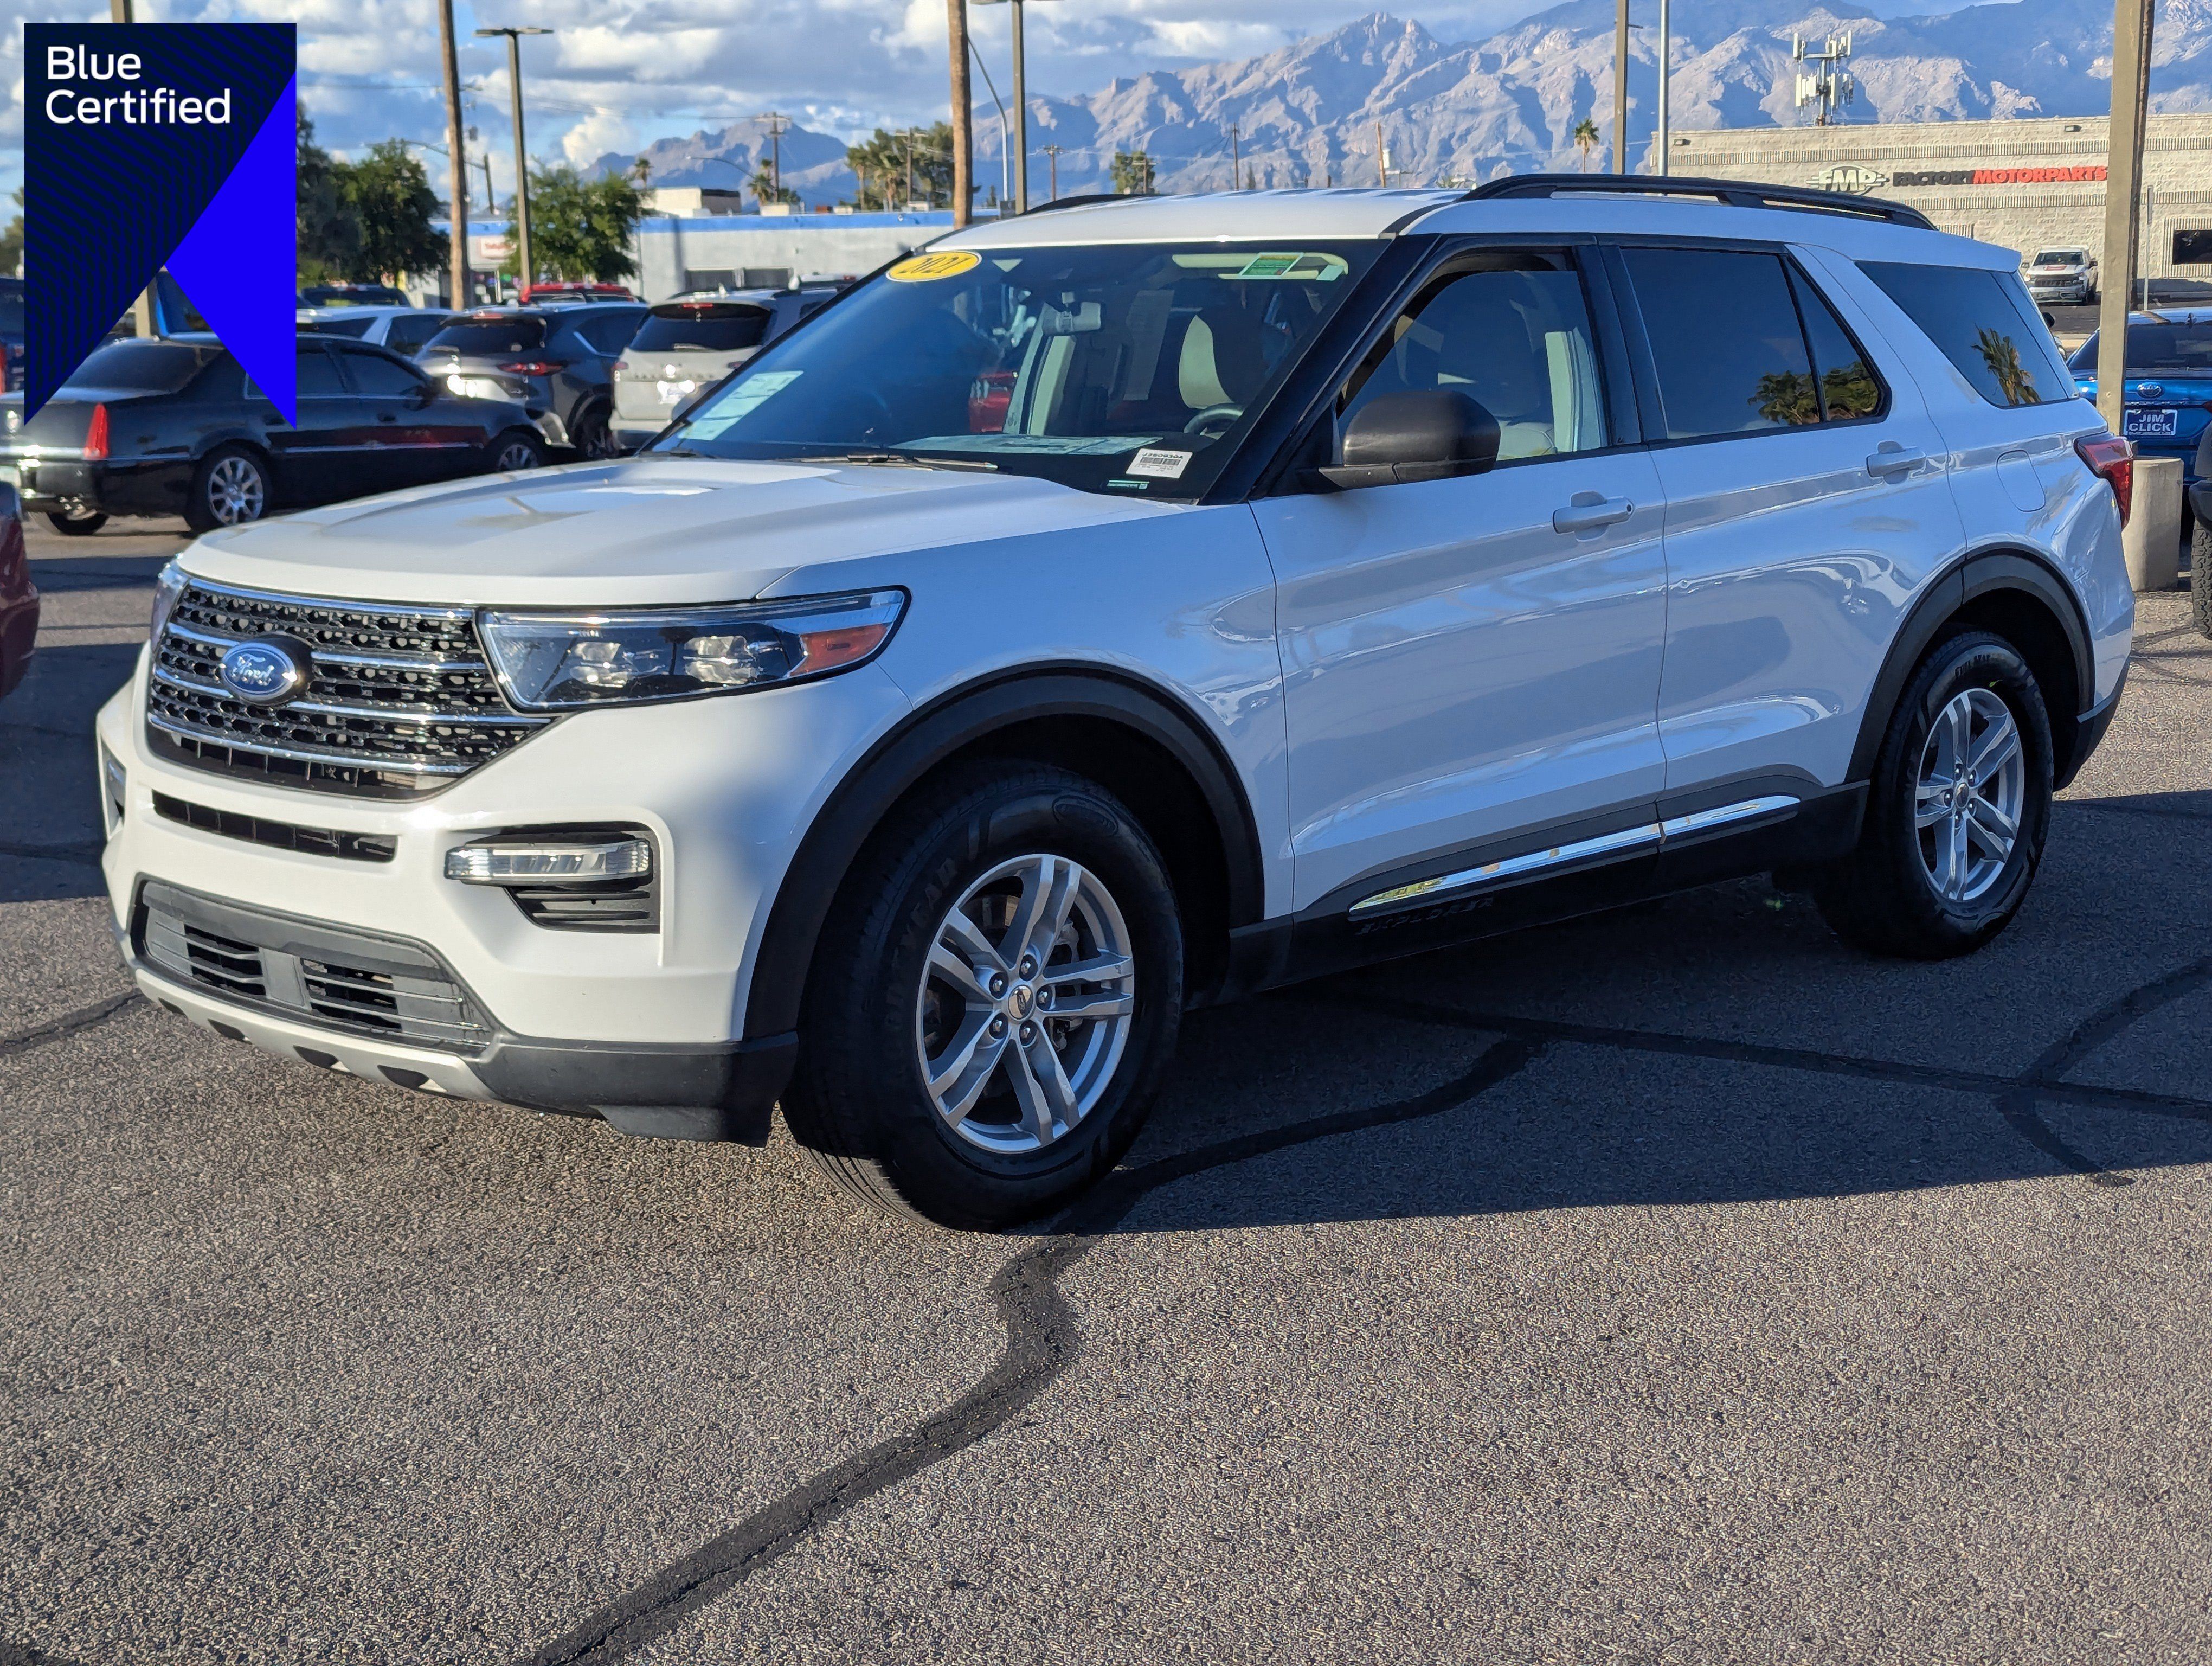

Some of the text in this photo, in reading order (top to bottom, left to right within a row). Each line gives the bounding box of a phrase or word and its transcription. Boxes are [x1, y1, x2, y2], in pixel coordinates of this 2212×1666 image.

[1818, 169, 1877, 191] FMP
[1893, 170, 1974, 187] FACTORY
[897, 256, 972, 274] 2021
[2139, 414, 2164, 422] JIM
[2129, 423, 2172, 432] CLICK
[232, 653, 275, 686] Ford
